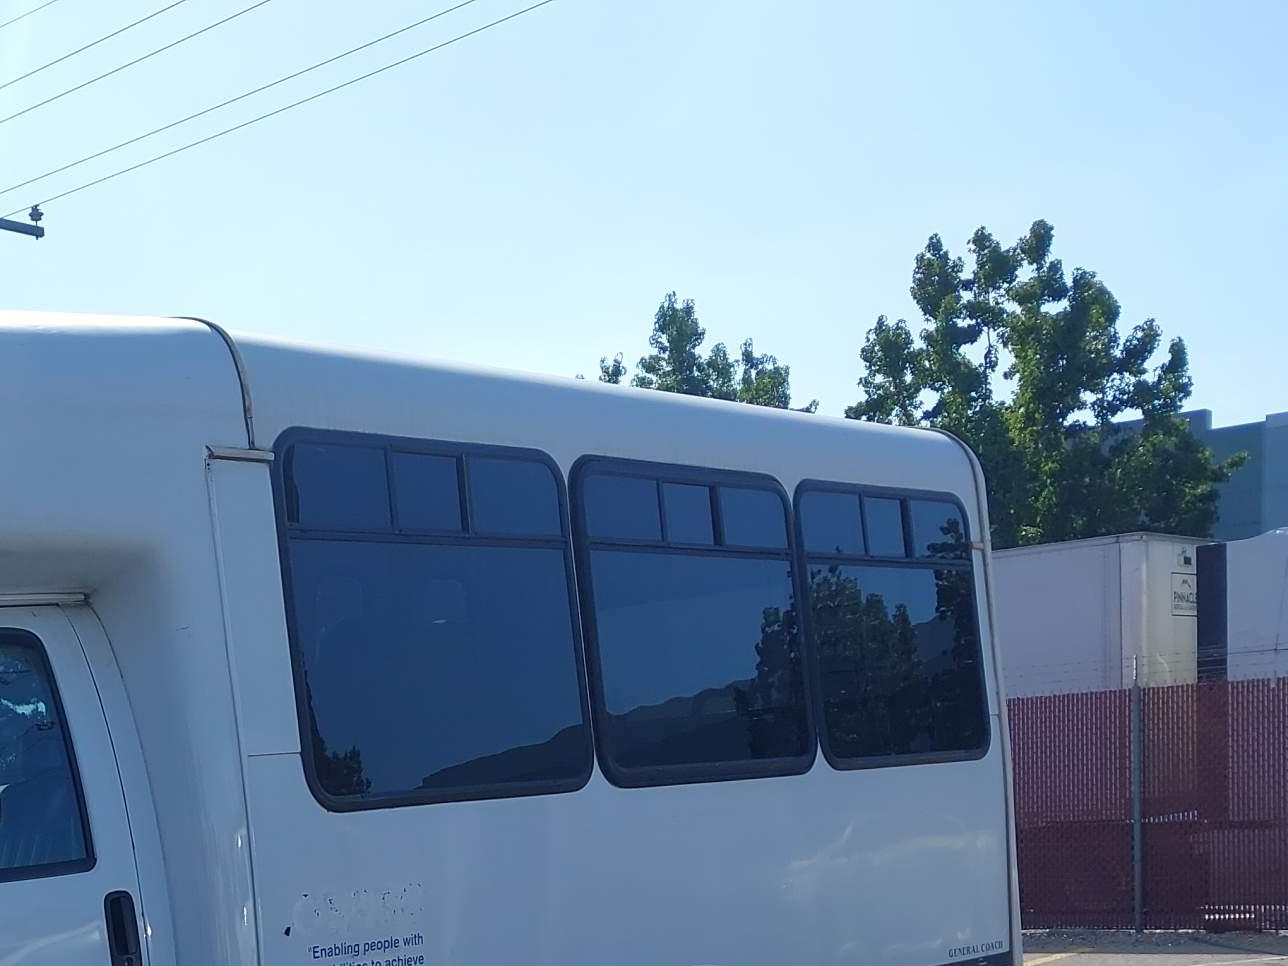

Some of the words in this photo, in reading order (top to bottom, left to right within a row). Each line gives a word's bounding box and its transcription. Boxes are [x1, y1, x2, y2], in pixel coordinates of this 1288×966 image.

[307, 941, 360, 960] "Enabling
[363, 935, 400, 956] people
[402, 932, 424, 947] with
[948, 944, 980, 958] GENERAL
[981, 940, 1003, 953] COACH
